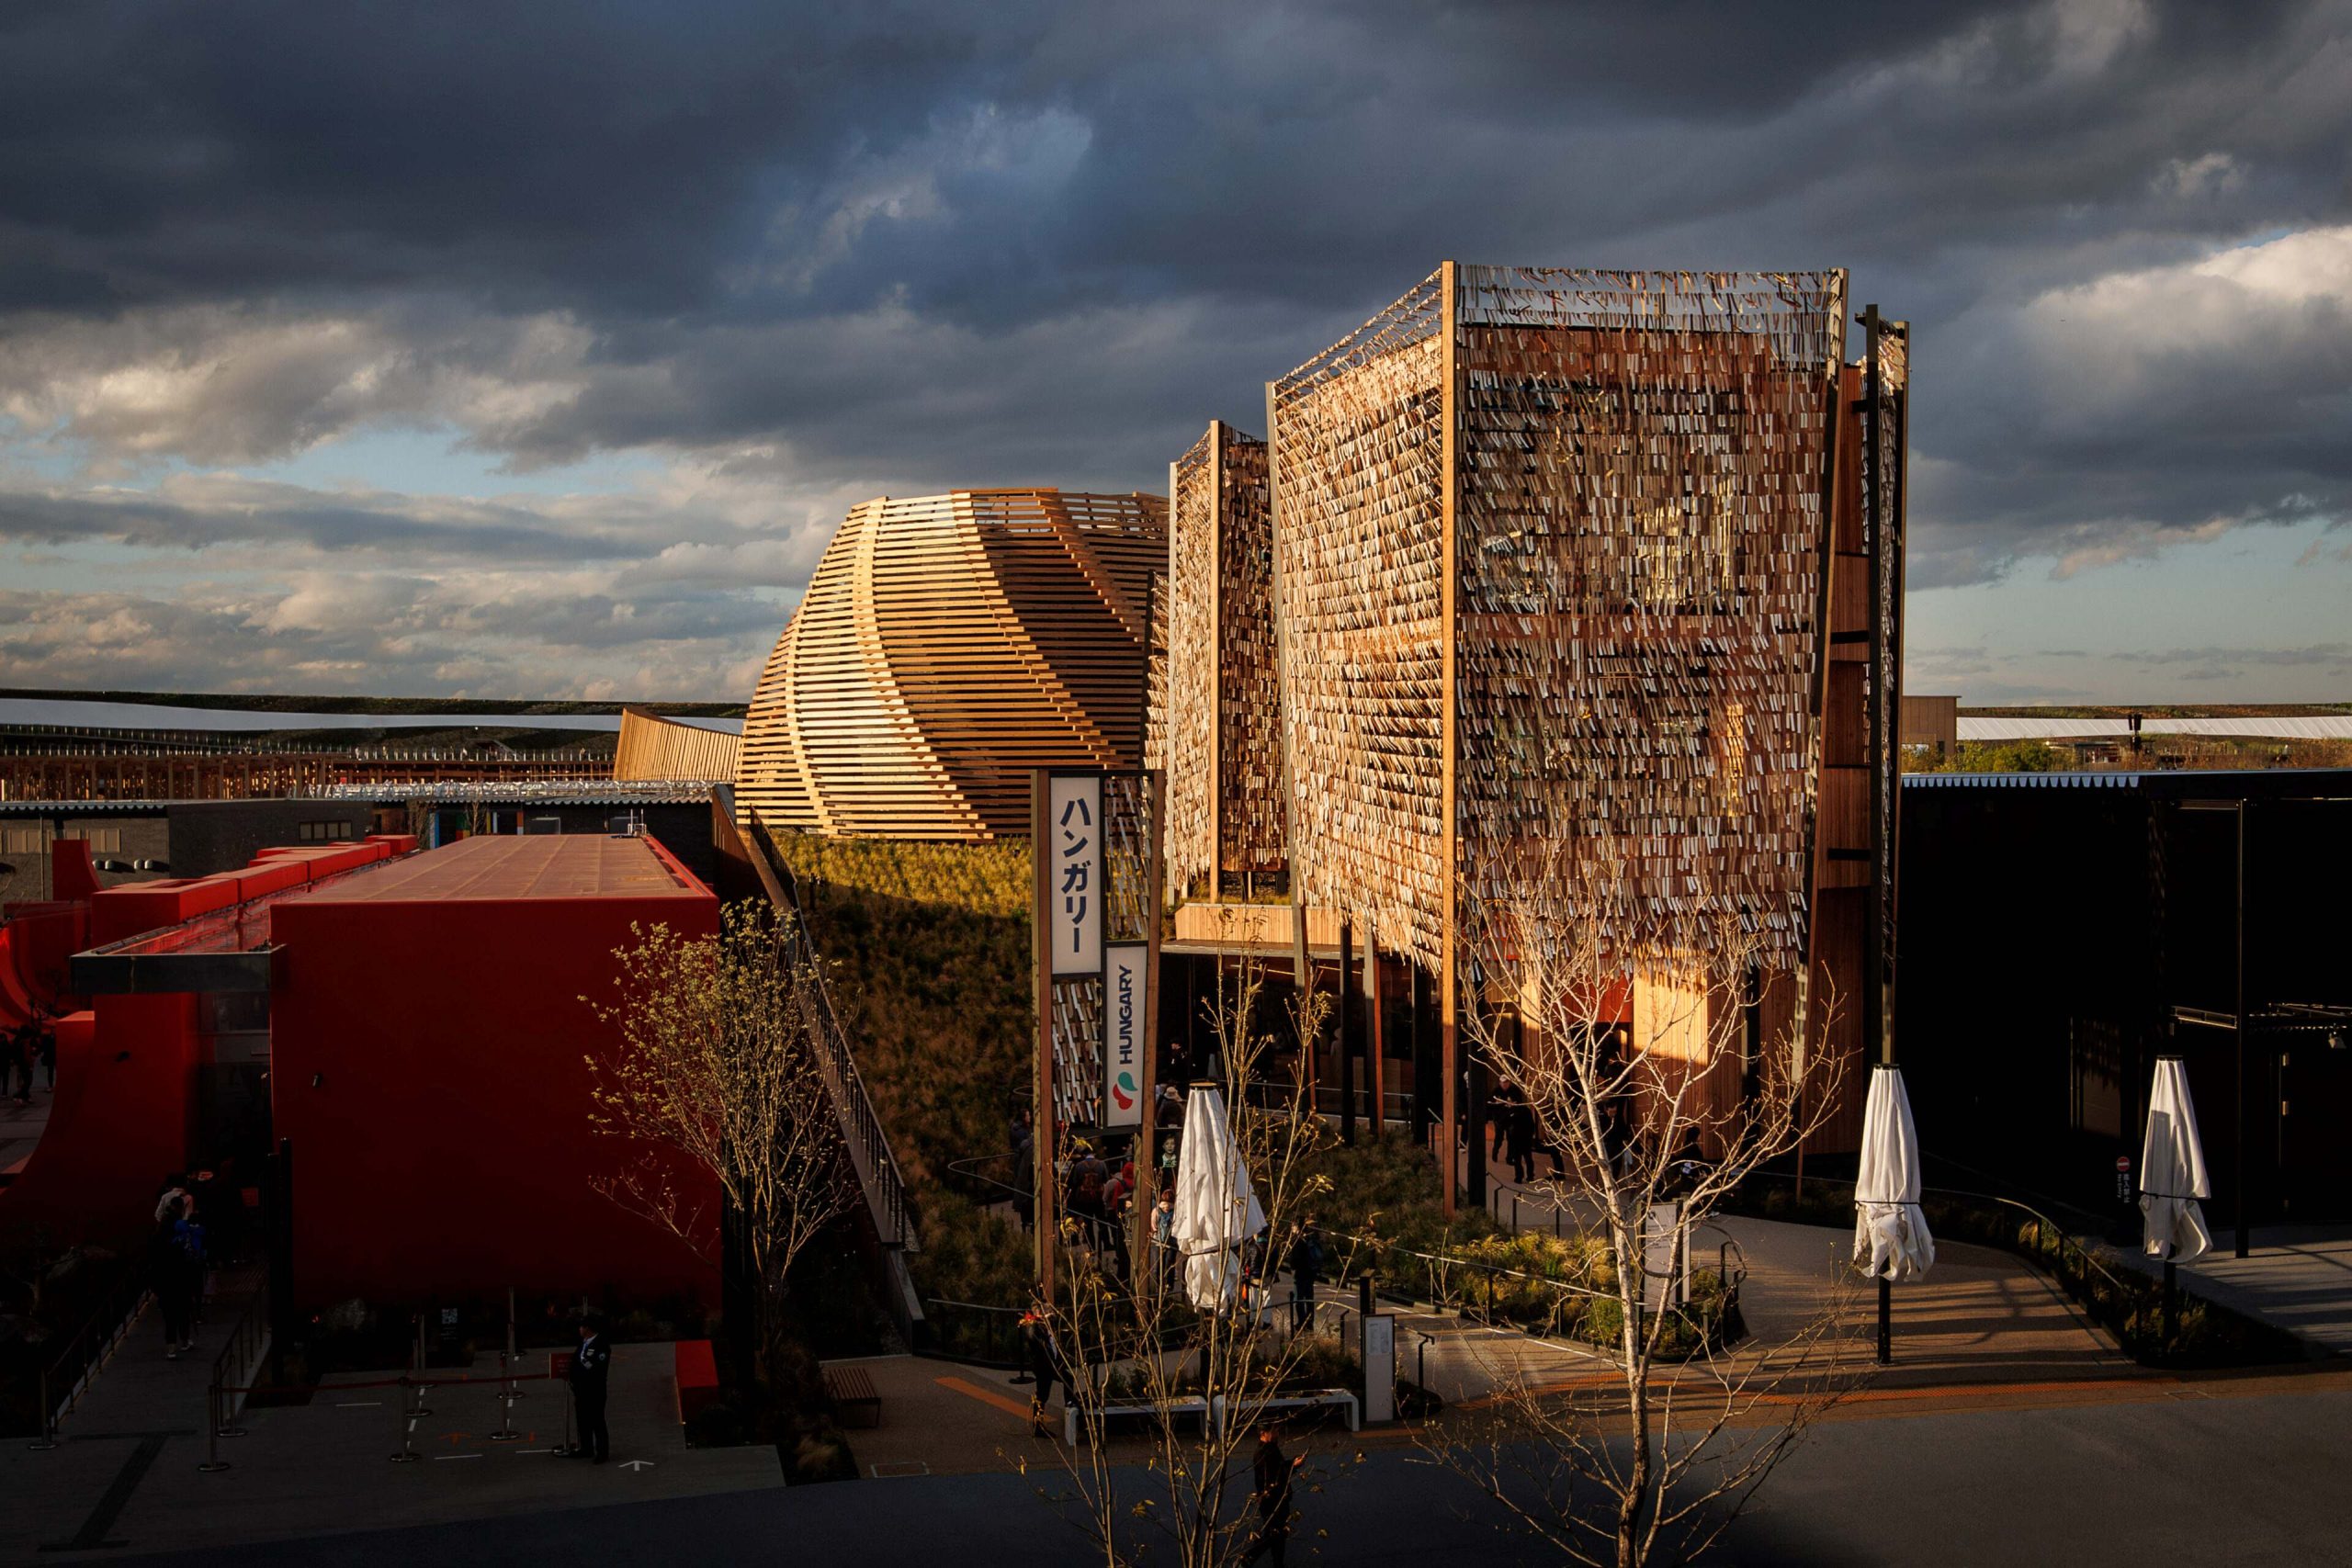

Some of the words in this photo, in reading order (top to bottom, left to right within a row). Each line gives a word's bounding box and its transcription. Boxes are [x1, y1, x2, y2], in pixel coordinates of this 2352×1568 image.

[1060, 797, 1091, 953] ハンガリー
[1119, 965, 1133, 1065] HUNGARY
